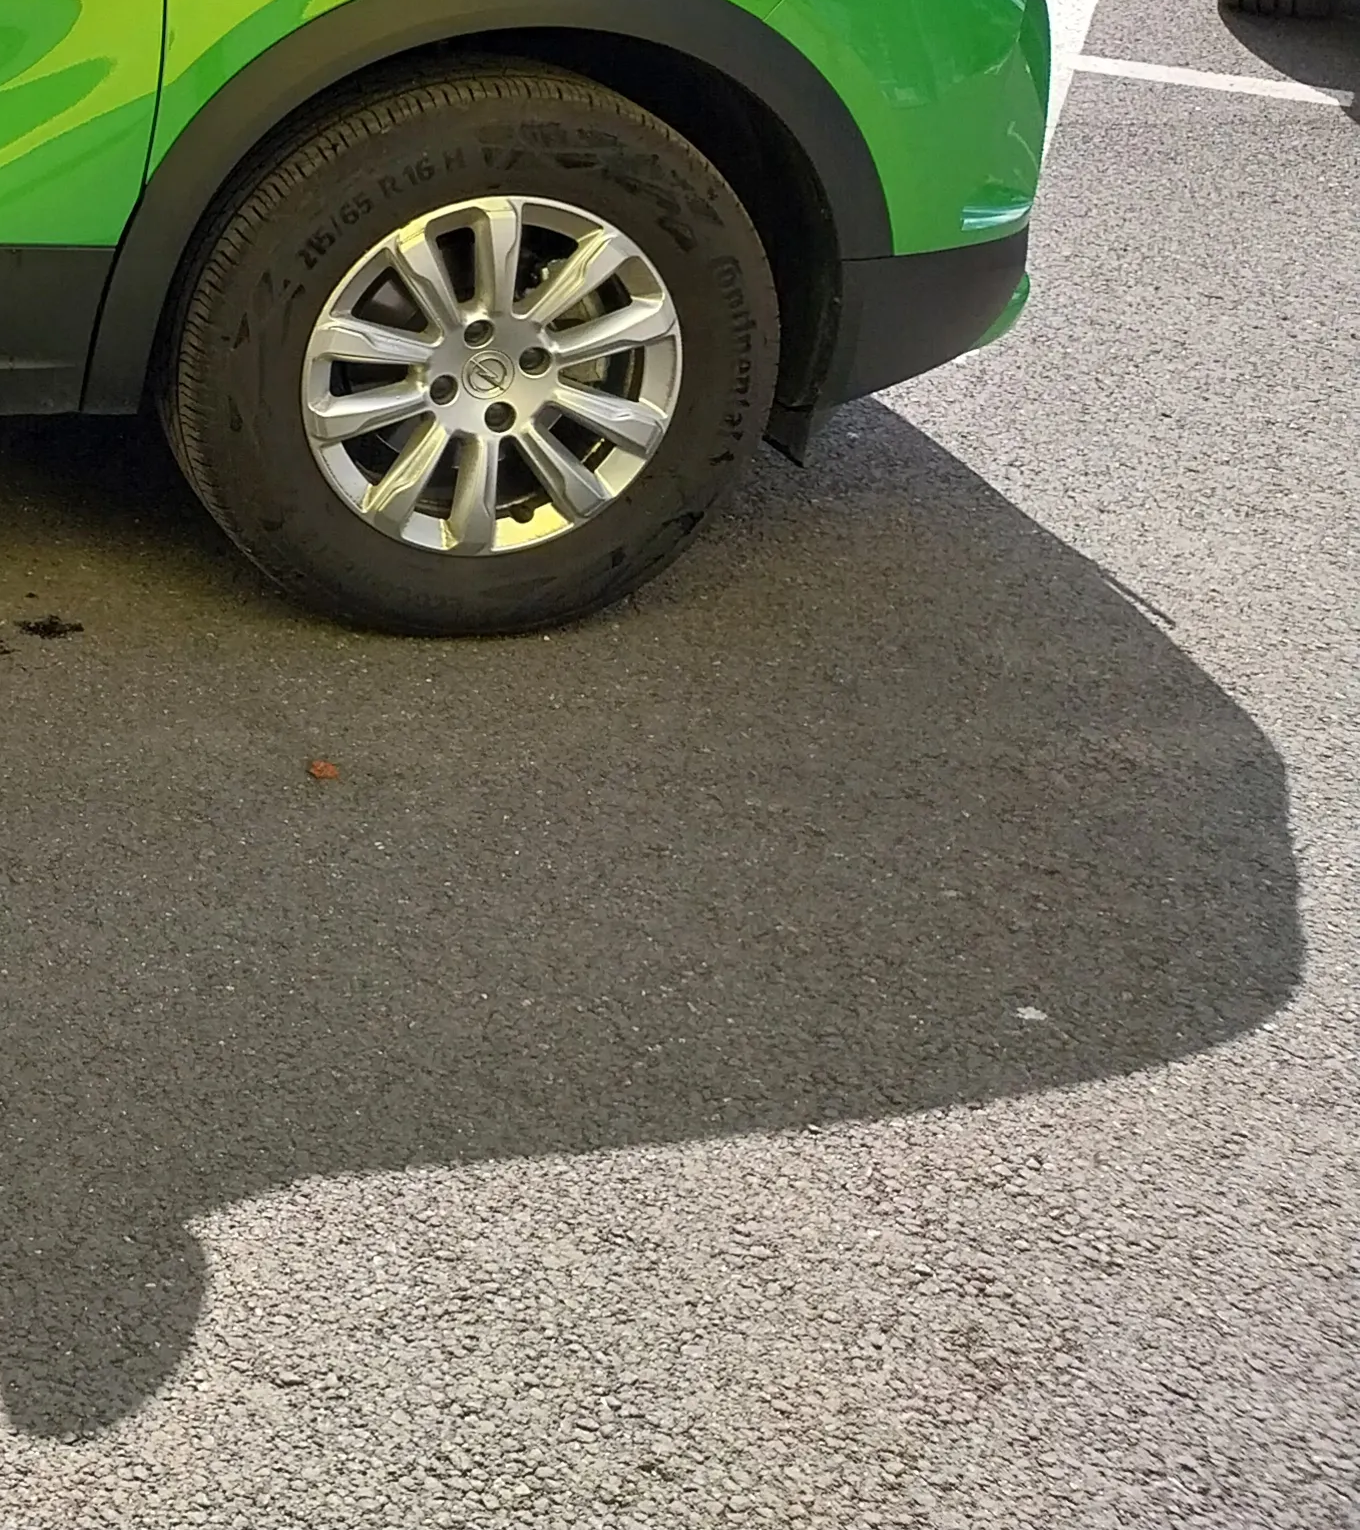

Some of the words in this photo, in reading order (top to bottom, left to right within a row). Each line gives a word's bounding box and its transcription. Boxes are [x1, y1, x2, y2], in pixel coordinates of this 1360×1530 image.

[296, 192, 374, 269] 215/65
[379, 174, 403, 199] R
[402, 158, 435, 186] 16
